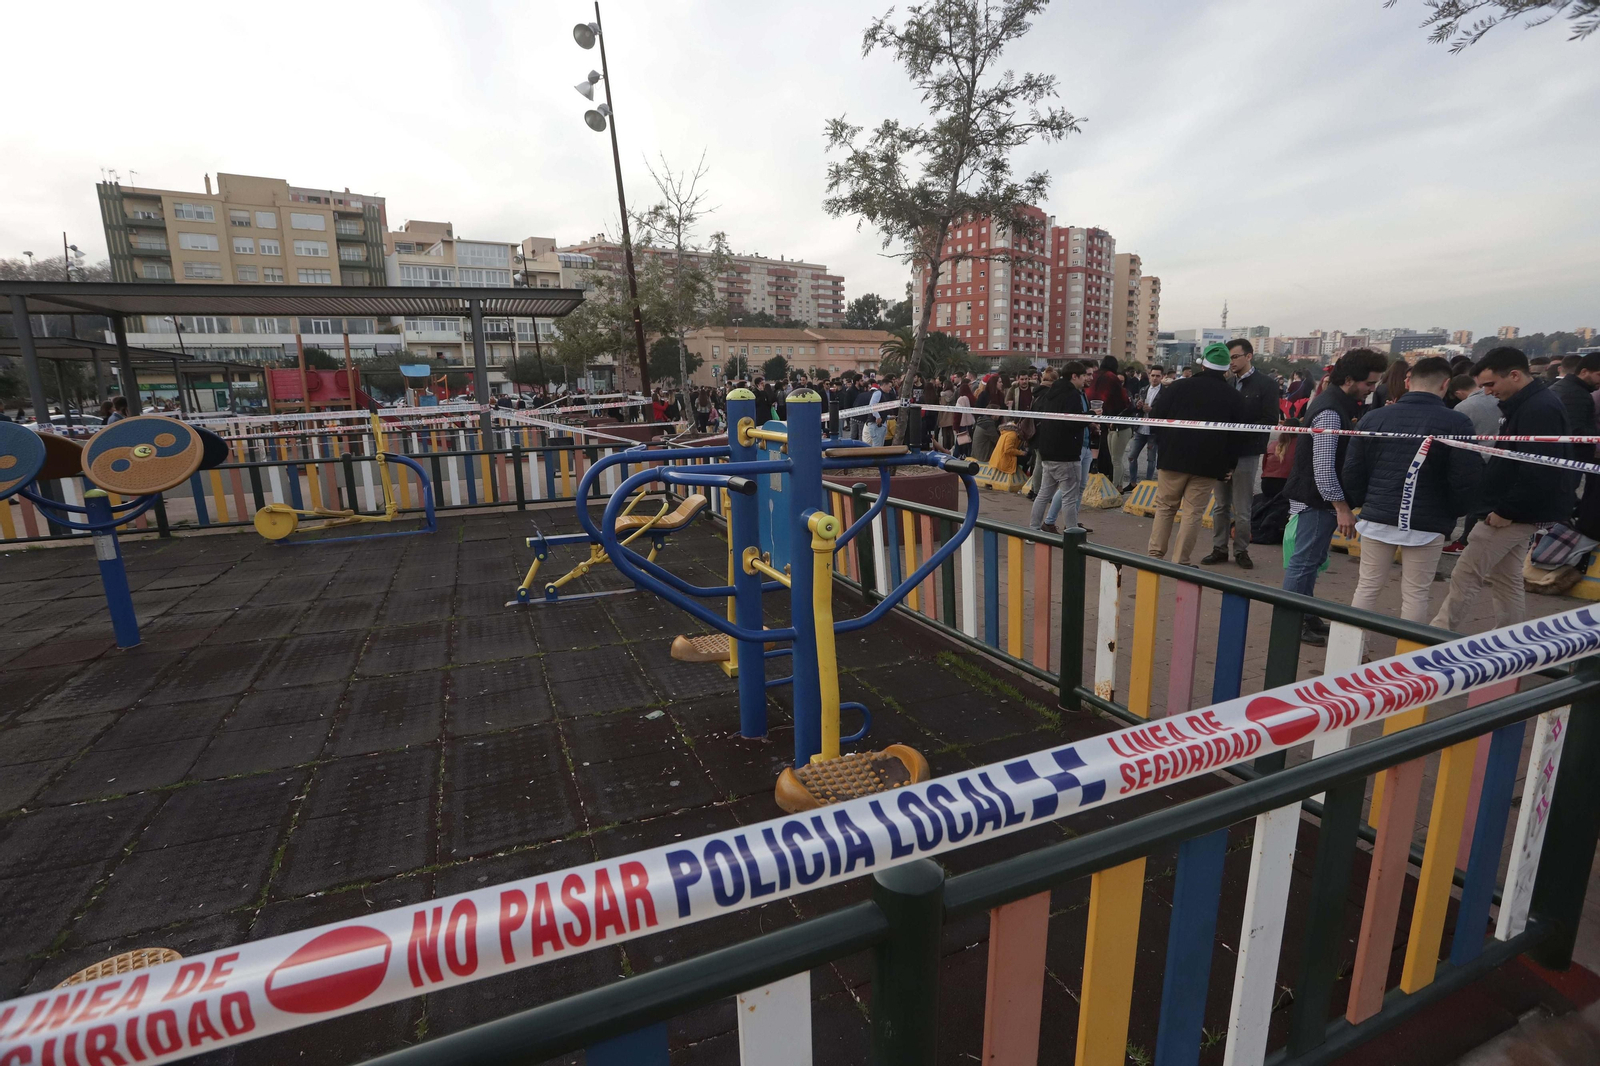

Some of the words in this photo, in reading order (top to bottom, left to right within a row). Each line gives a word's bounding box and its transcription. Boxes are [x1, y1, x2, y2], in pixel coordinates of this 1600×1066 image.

[1107, 722, 1186, 758] LINEA
[1196, 710, 1234, 736] DE
[1119, 727, 1262, 795] SEGURIDAD
[407, 898, 479, 988] NO
[499, 861, 660, 966] PASAR
[665, 808, 876, 918] POLICIA
[868, 772, 1026, 860] LOCAL
[161, 951, 240, 1002] DE
